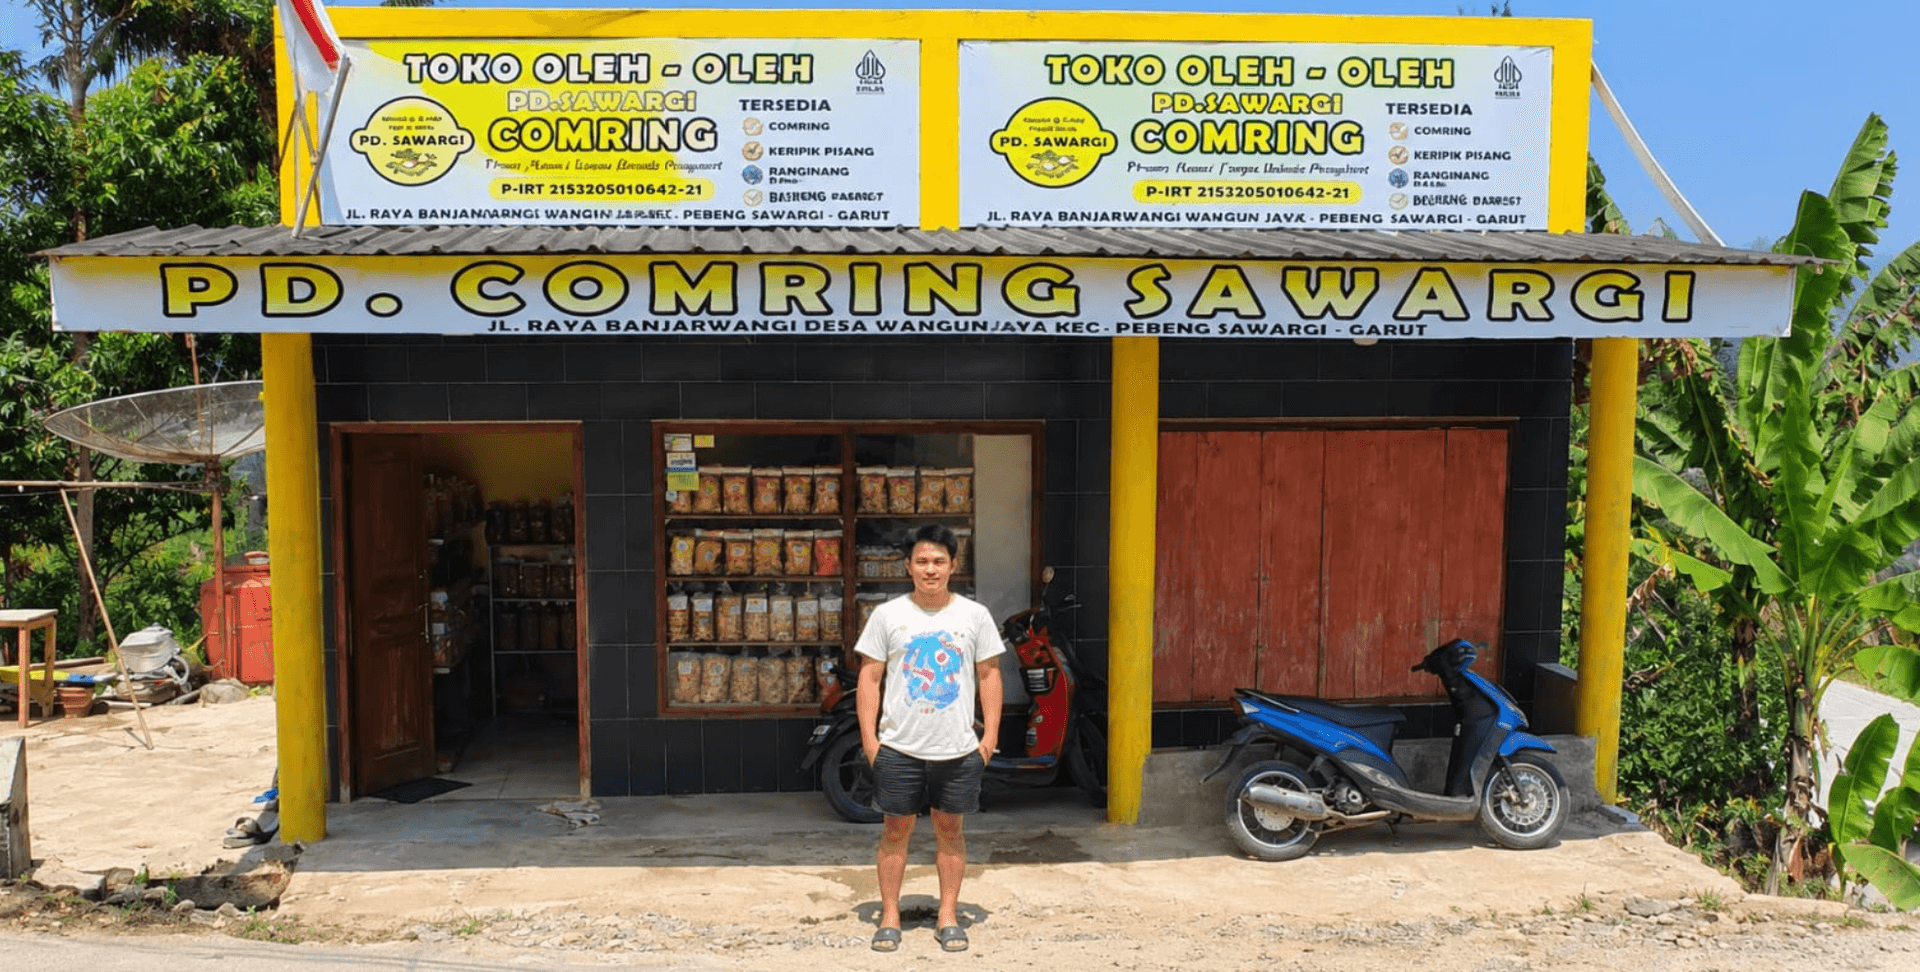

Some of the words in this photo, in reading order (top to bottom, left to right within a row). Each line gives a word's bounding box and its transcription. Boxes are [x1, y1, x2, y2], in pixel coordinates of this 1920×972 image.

[402, 53, 523, 85] TOKO
[532, 53, 650, 85] OLEH
[662, 64, 682, 77] -
[693, 53, 814, 85] OLEH
[1044, 54, 1166, 86] TOKO
[1176, 55, 1295, 87] OLEH
[1306, 66, 1327, 80] -
[1338, 57, 1455, 89] OLEH
[739, 99, 831, 111] TERSEDIA
[1385, 103, 1473, 115] TERSEDIA
[768, 122, 830, 131] COMRING
[1414, 126, 1472, 136] COMRING
[359, 135, 387, 146] PD.
[393, 135, 465, 146] SAWARGI
[488, 117, 718, 153] COMRING
[1131, 119, 1365, 156] COMRING
[1000, 137, 1027, 148] PD.
[1034, 137, 1108, 148] SAWARGI
[769, 147, 820, 156] KERIPIK
[824, 147, 874, 157] PISANG
[1414, 150, 1462, 160] KERIPIK
[1465, 151, 1512, 161] PISANG
[769, 167, 850, 177] RANGINANG
[1413, 171, 1490, 181] RANGINANG
[501, 184, 544, 195] P-IRT
[550, 184, 702, 195] 2153205010642-21
[1146, 186, 1191, 197] P-IRT
[1198, 187, 1349, 198] 2153205010642-21
[346, 209, 366, 220] JL.
[370, 209, 413, 219] RAYA
[683, 210, 746, 219] PEBENG
[752, 211, 824, 220] SAWARGI
[837, 211, 890, 220] GARUT
[986, 211, 1006, 222] JL.
[1010, 212, 1054, 222] RAYA
[1058, 212, 1181, 222] BANJARWANGI
[1185, 212, 1259, 223] WANGUN
[1319, 214, 1383, 223] PEBENG
[1390, 214, 1463, 223] SAWARGI
[1476, 214, 1526, 224] GARUT
[160, 262, 403, 318] PD.
[450, 260, 1080, 320] COMRING
[1123, 262, 1697, 324] SAWARGI
[487, 319, 520, 332] JL.
[527, 319, 597, 332] RAYA
[605, 319, 797, 332] BANJARWANGI
[804, 319, 868, 332] DESA
[1116, 322, 1211, 334] PEBENG
[1218, 323, 1327, 336] SAWARGI
[1349, 323, 1428, 336] GARUT
